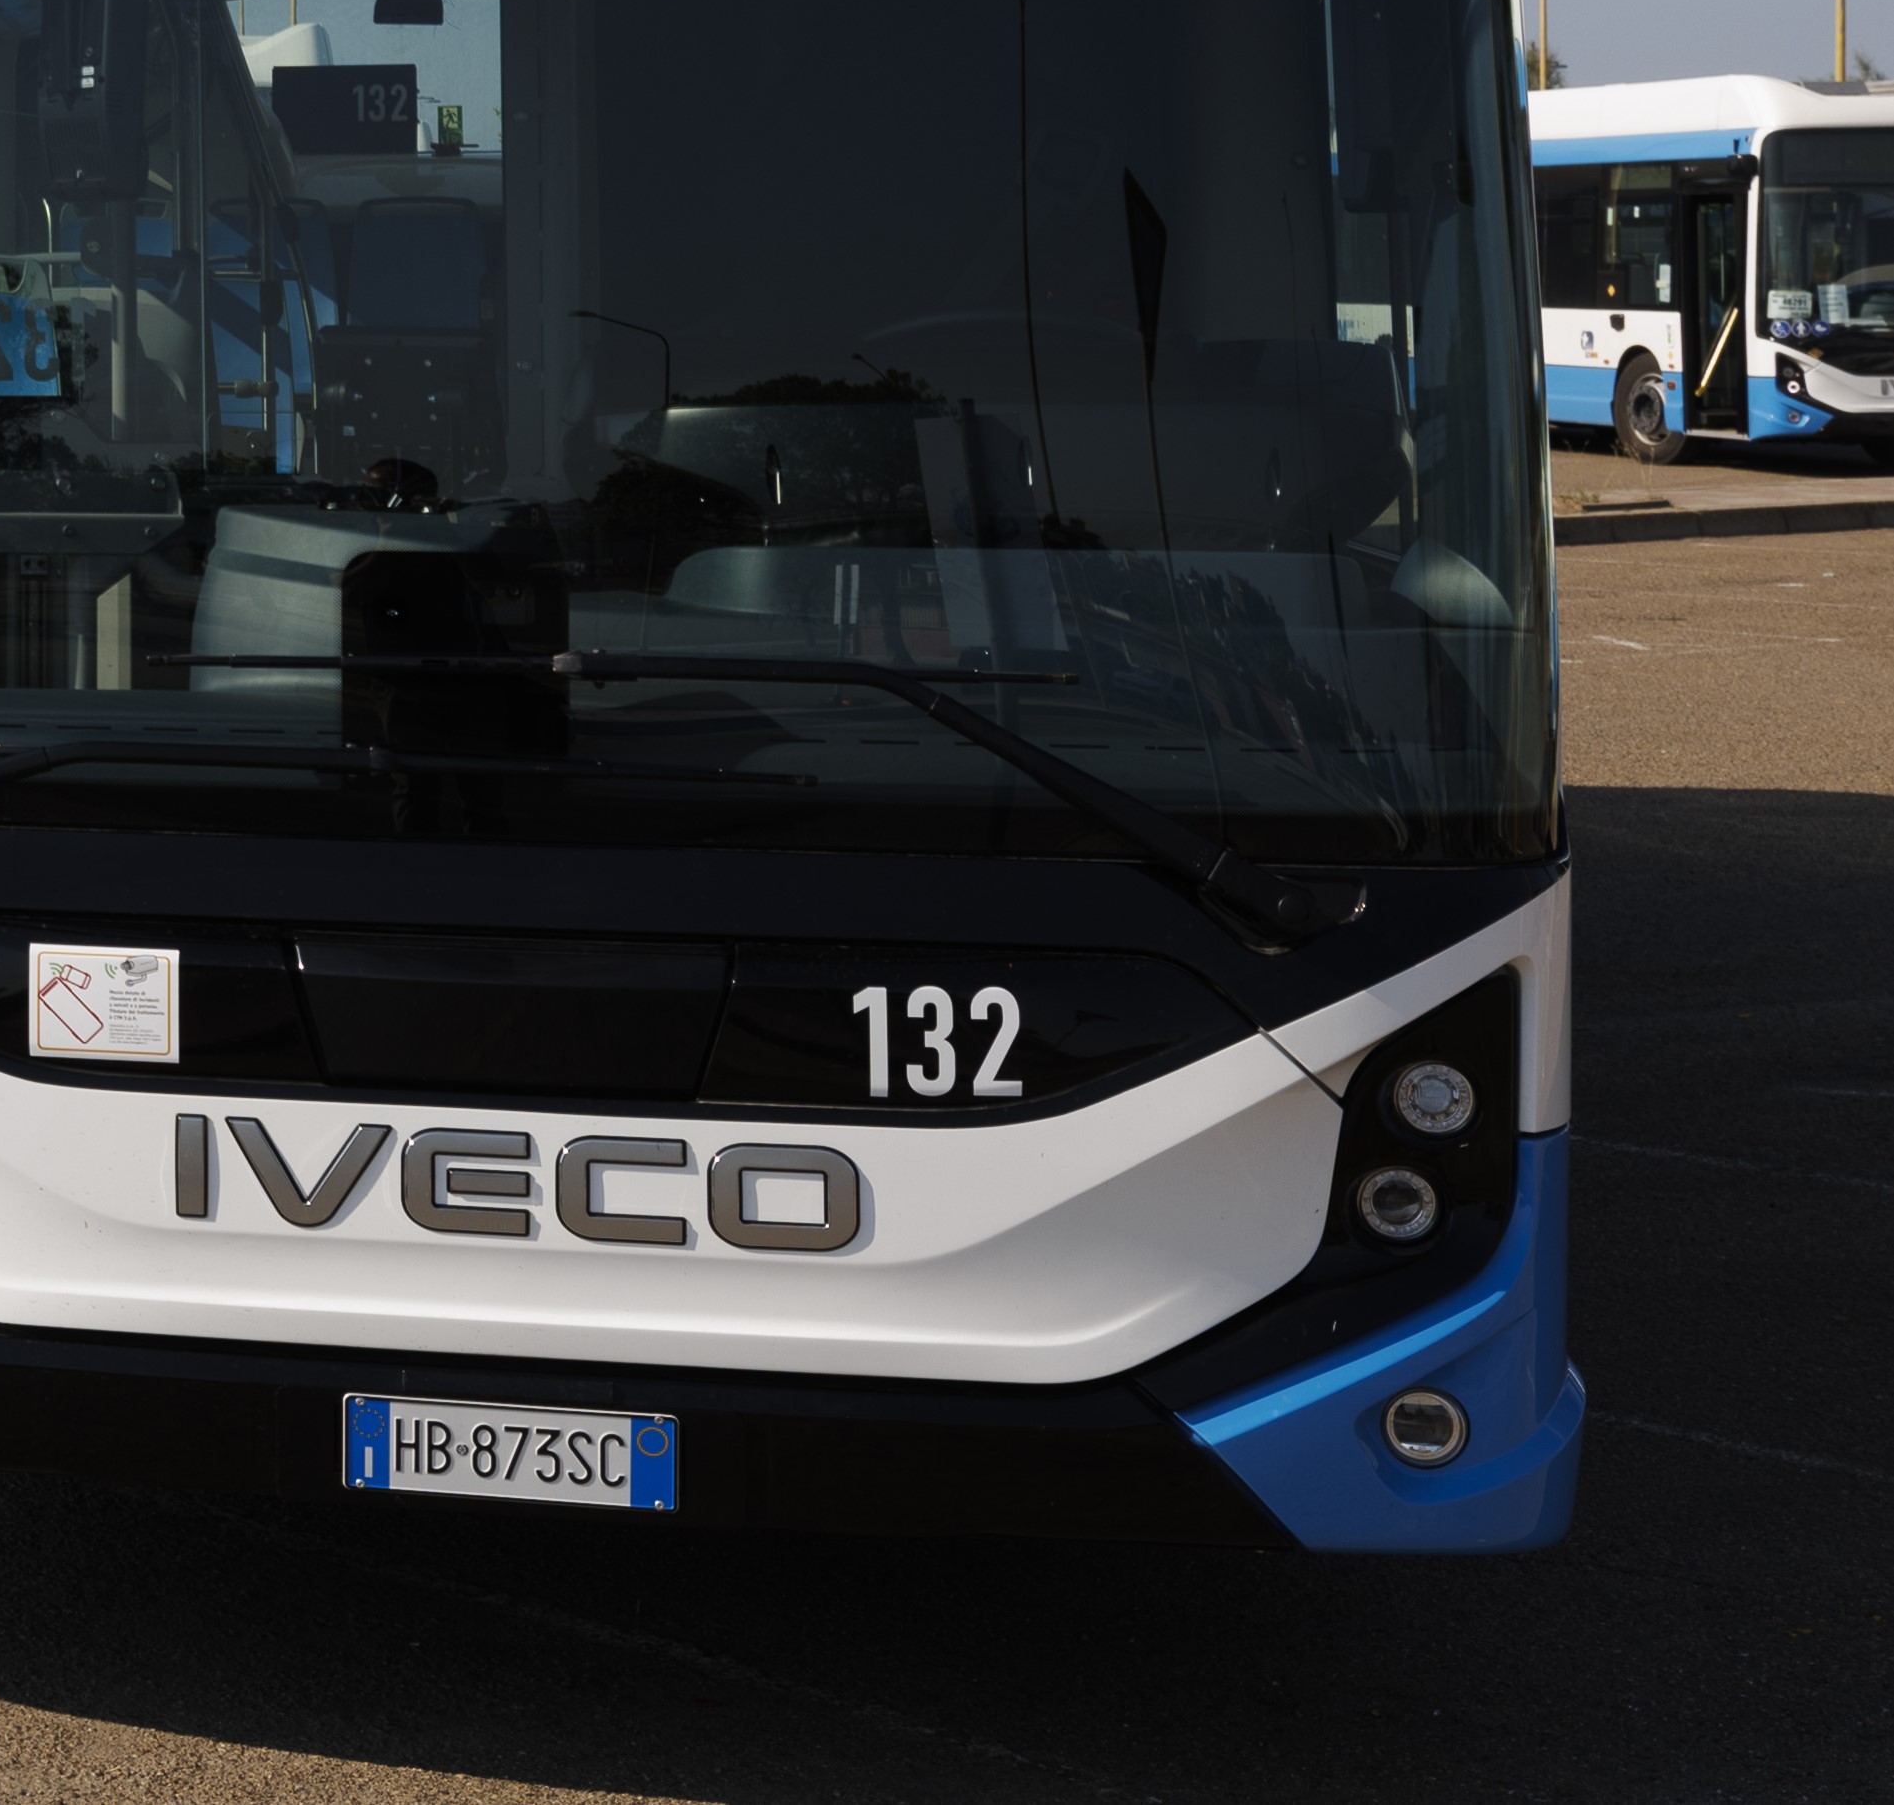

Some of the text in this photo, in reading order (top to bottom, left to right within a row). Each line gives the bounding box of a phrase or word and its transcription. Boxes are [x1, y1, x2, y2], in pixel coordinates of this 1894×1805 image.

[353, 83, 408, 122] 132
[852, 985, 1023, 1097] 132
[175, 1113, 861, 1252] IVECO
